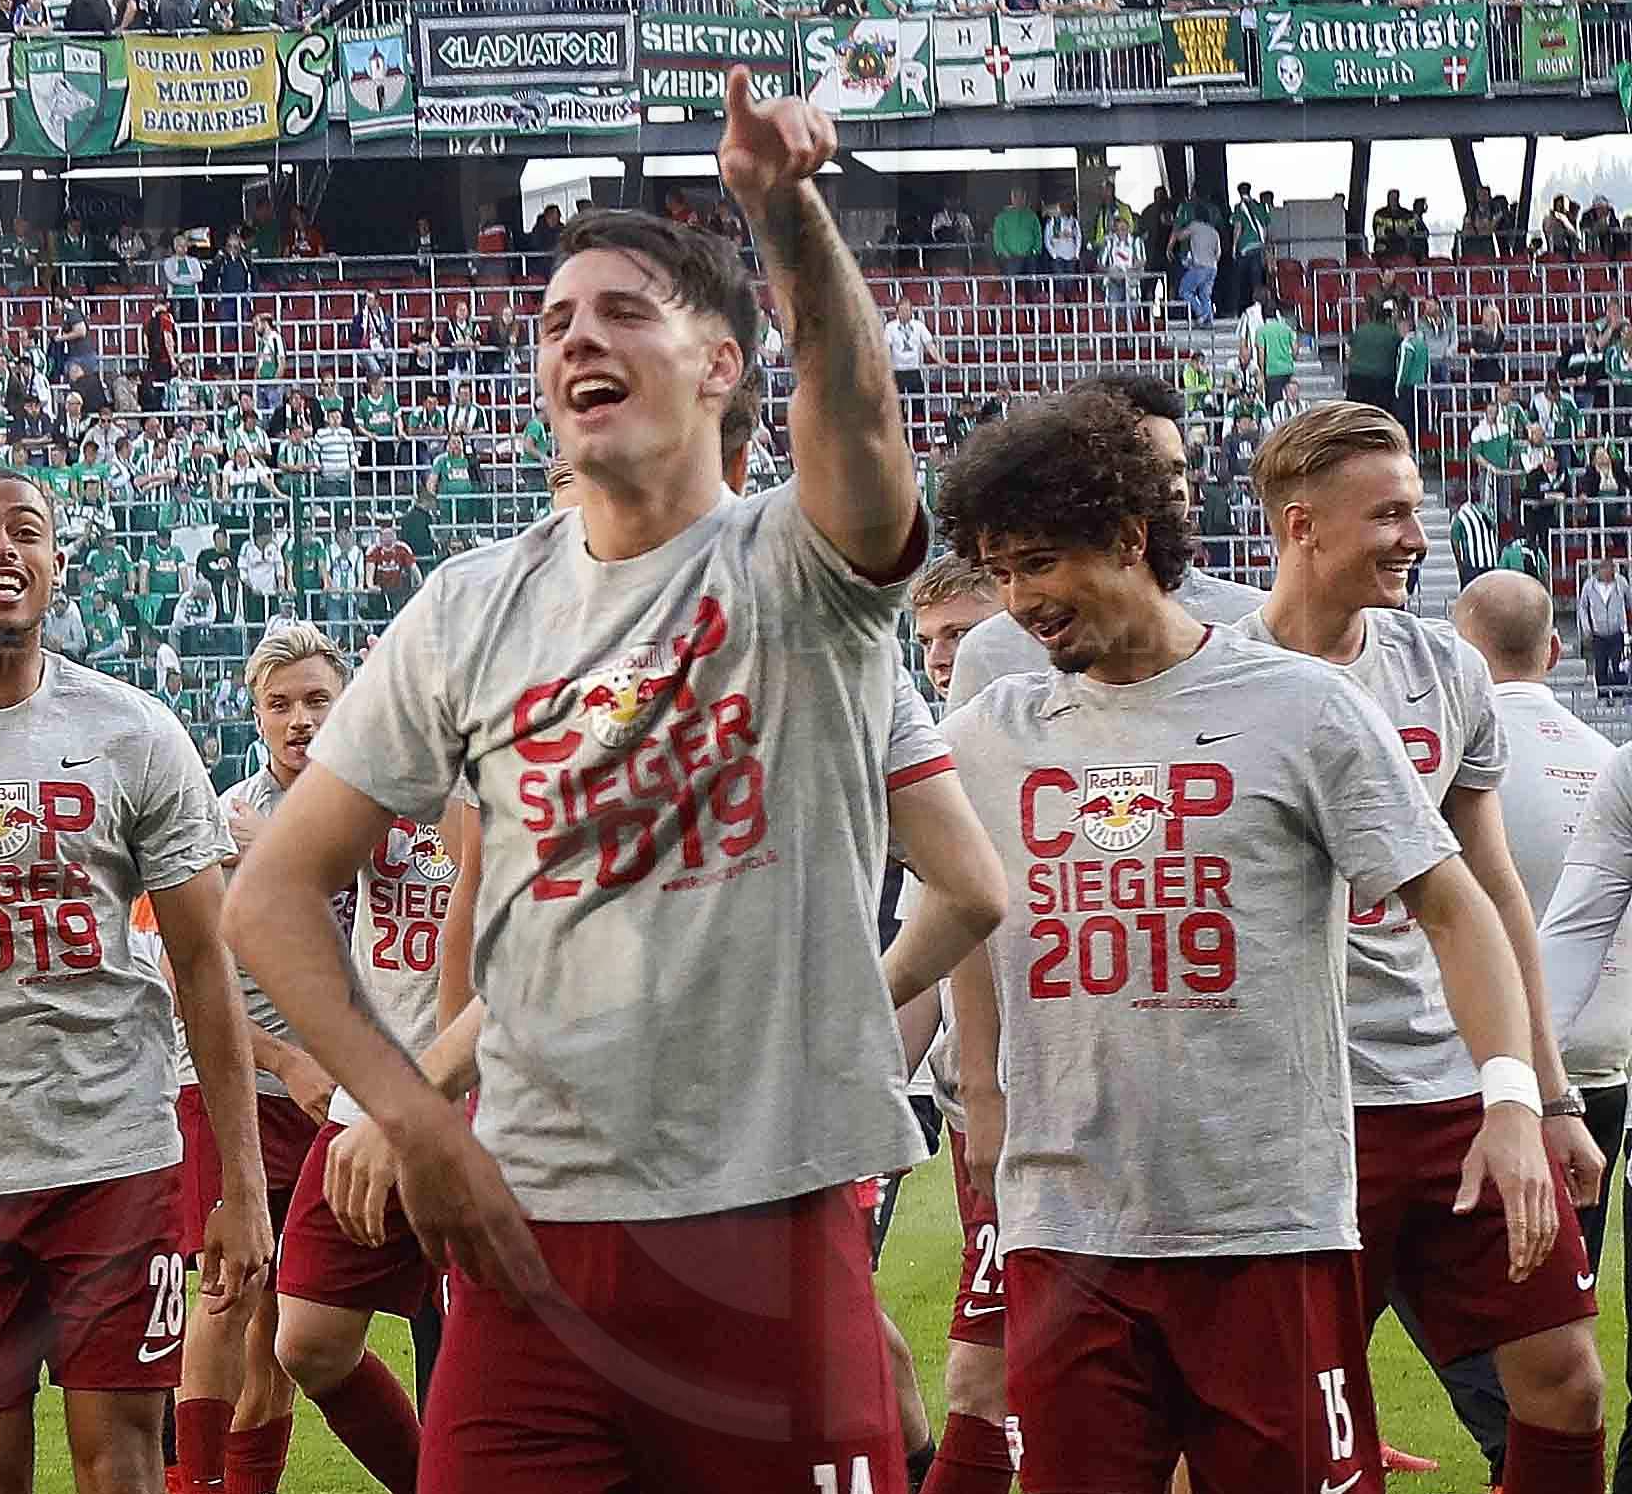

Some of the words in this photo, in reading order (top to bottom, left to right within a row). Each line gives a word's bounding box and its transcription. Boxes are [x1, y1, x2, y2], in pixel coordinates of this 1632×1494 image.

[439, 32, 617, 68] GLADIATORI
[643, 24, 785, 54] SEKTION
[1267, 10, 1479, 58] Zaungäste
[134, 49, 202, 72] CURVA
[212, 48, 265, 70] NORD
[1335, 57, 1415, 89] Rapid
[157, 80, 249, 101] MATTEO
[643, 69, 785, 100] MEIDNG
[144, 107, 267, 132] BAGNARESI
[514, 596, 731, 762] CP
[519, 694, 758, 835] SIEGER
[1089, 772, 1119, 790] Red
[1122, 771, 1152, 789] Bull
[534, 757, 770, 903] 2019
[1021, 763, 1234, 858] CP
[370, 880, 450, 919] SIEG
[1028, 856, 1234, 914] SIEGER
[372, 917, 440, 972] 20
[1029, 911, 1236, 999] 2019
[145, 1253, 184, 1338] 28
[1318, 1369, 1354, 1461] 15
